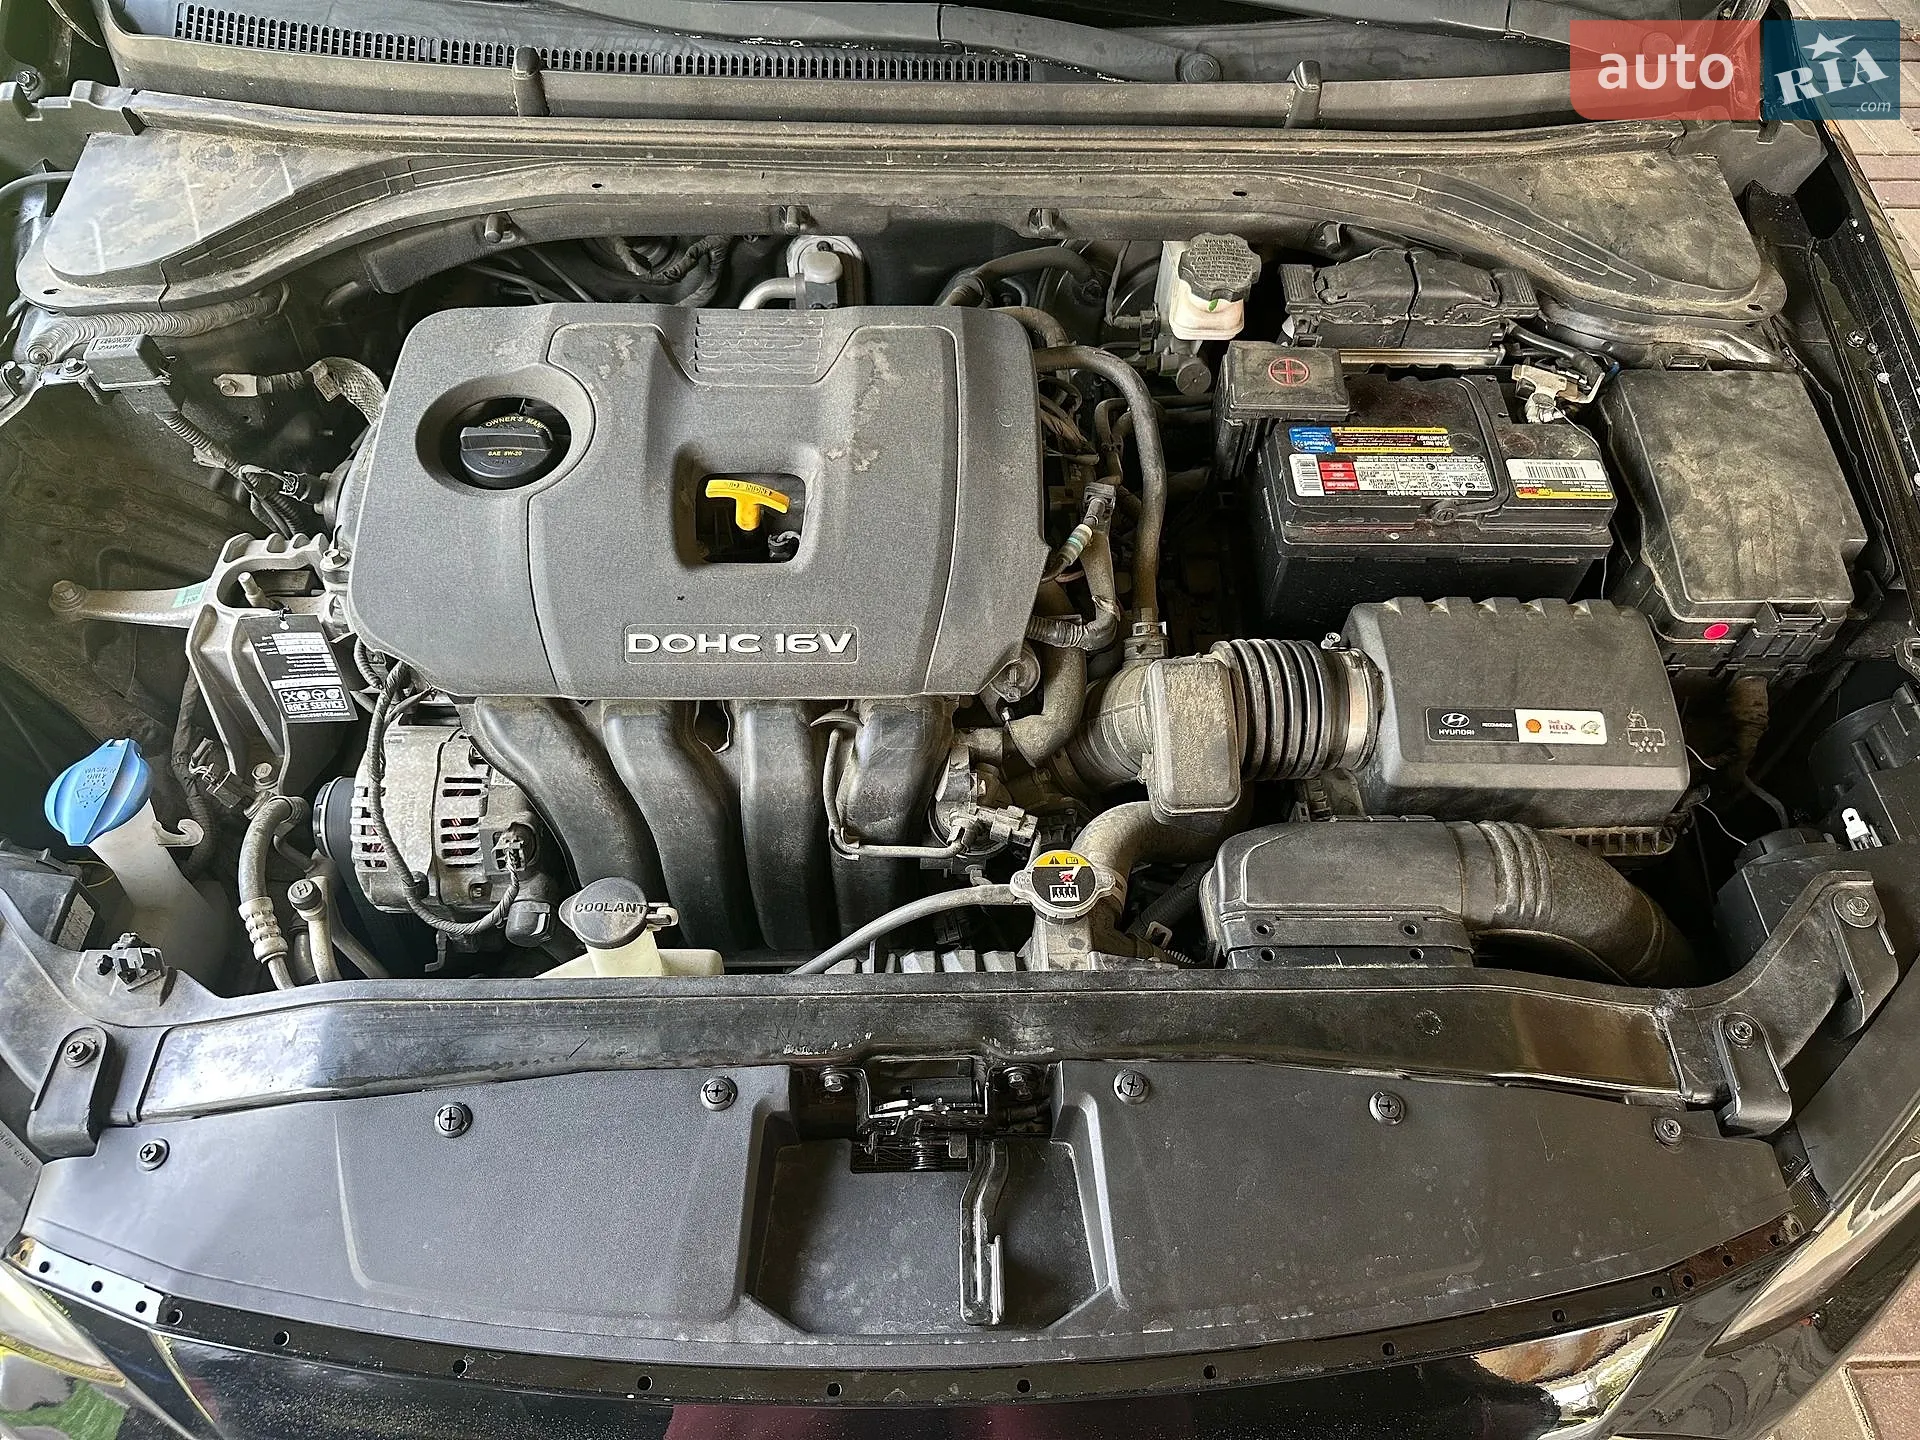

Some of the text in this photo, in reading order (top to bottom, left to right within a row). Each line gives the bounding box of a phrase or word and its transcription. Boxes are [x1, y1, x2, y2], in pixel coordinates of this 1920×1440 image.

[485, 415, 524, 427] OWNER'S
[627, 633, 853, 654] DOHC 16V
[287, 701, 345, 712] RACE SERVICE
[1549, 723, 1577, 731] HELIX
[574, 902, 647, 914] COOLANT
